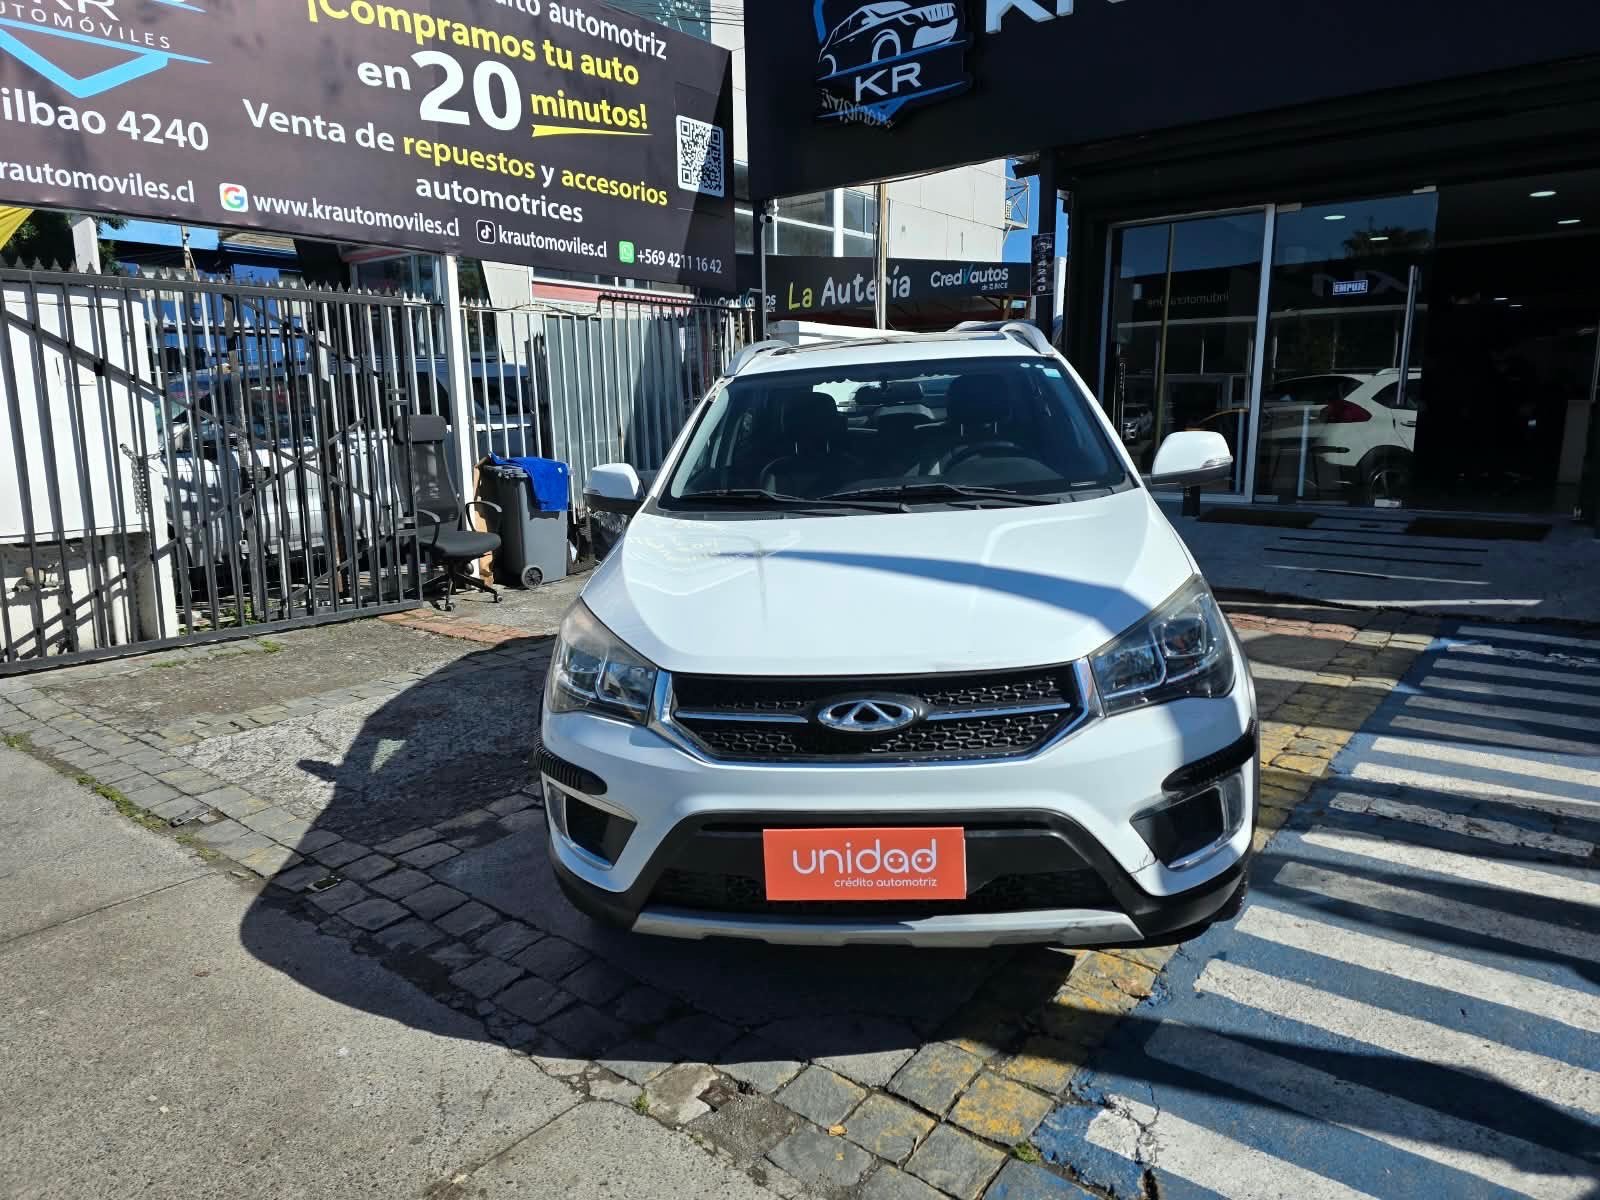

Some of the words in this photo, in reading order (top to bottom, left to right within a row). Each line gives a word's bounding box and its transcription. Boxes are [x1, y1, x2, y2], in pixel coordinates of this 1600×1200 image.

[549, 2, 667, 60] automotriz
[542, 39, 574, 71] tu
[580, 53, 640, 86] auto
[855, 62, 922, 102] KR
[357, 61, 411, 91] en
[411, 50, 522, 131] 20
[531, 89, 648, 129] minutos!
[117, 110, 209, 151] 4240
[243, 99, 347, 143] Venta
[355, 122, 395, 152] de
[403, 136, 536, 181] repuestos
[541, 164, 555, 187] y
[561, 167, 668, 206] accesorios
[252, 194, 460, 237] www.krautomoviles.cl
[416, 178, 583, 223] automotrices
[499, 224, 607, 258] krautomoviles.cl
[637, 248, 665, 266] +569
[709, 259, 722, 274] 42
[788, 282, 813, 310] La
[792, 838, 937, 875] unidad
[834, 877, 874, 888] crédito
[876, 877, 937, 887] automotriz
